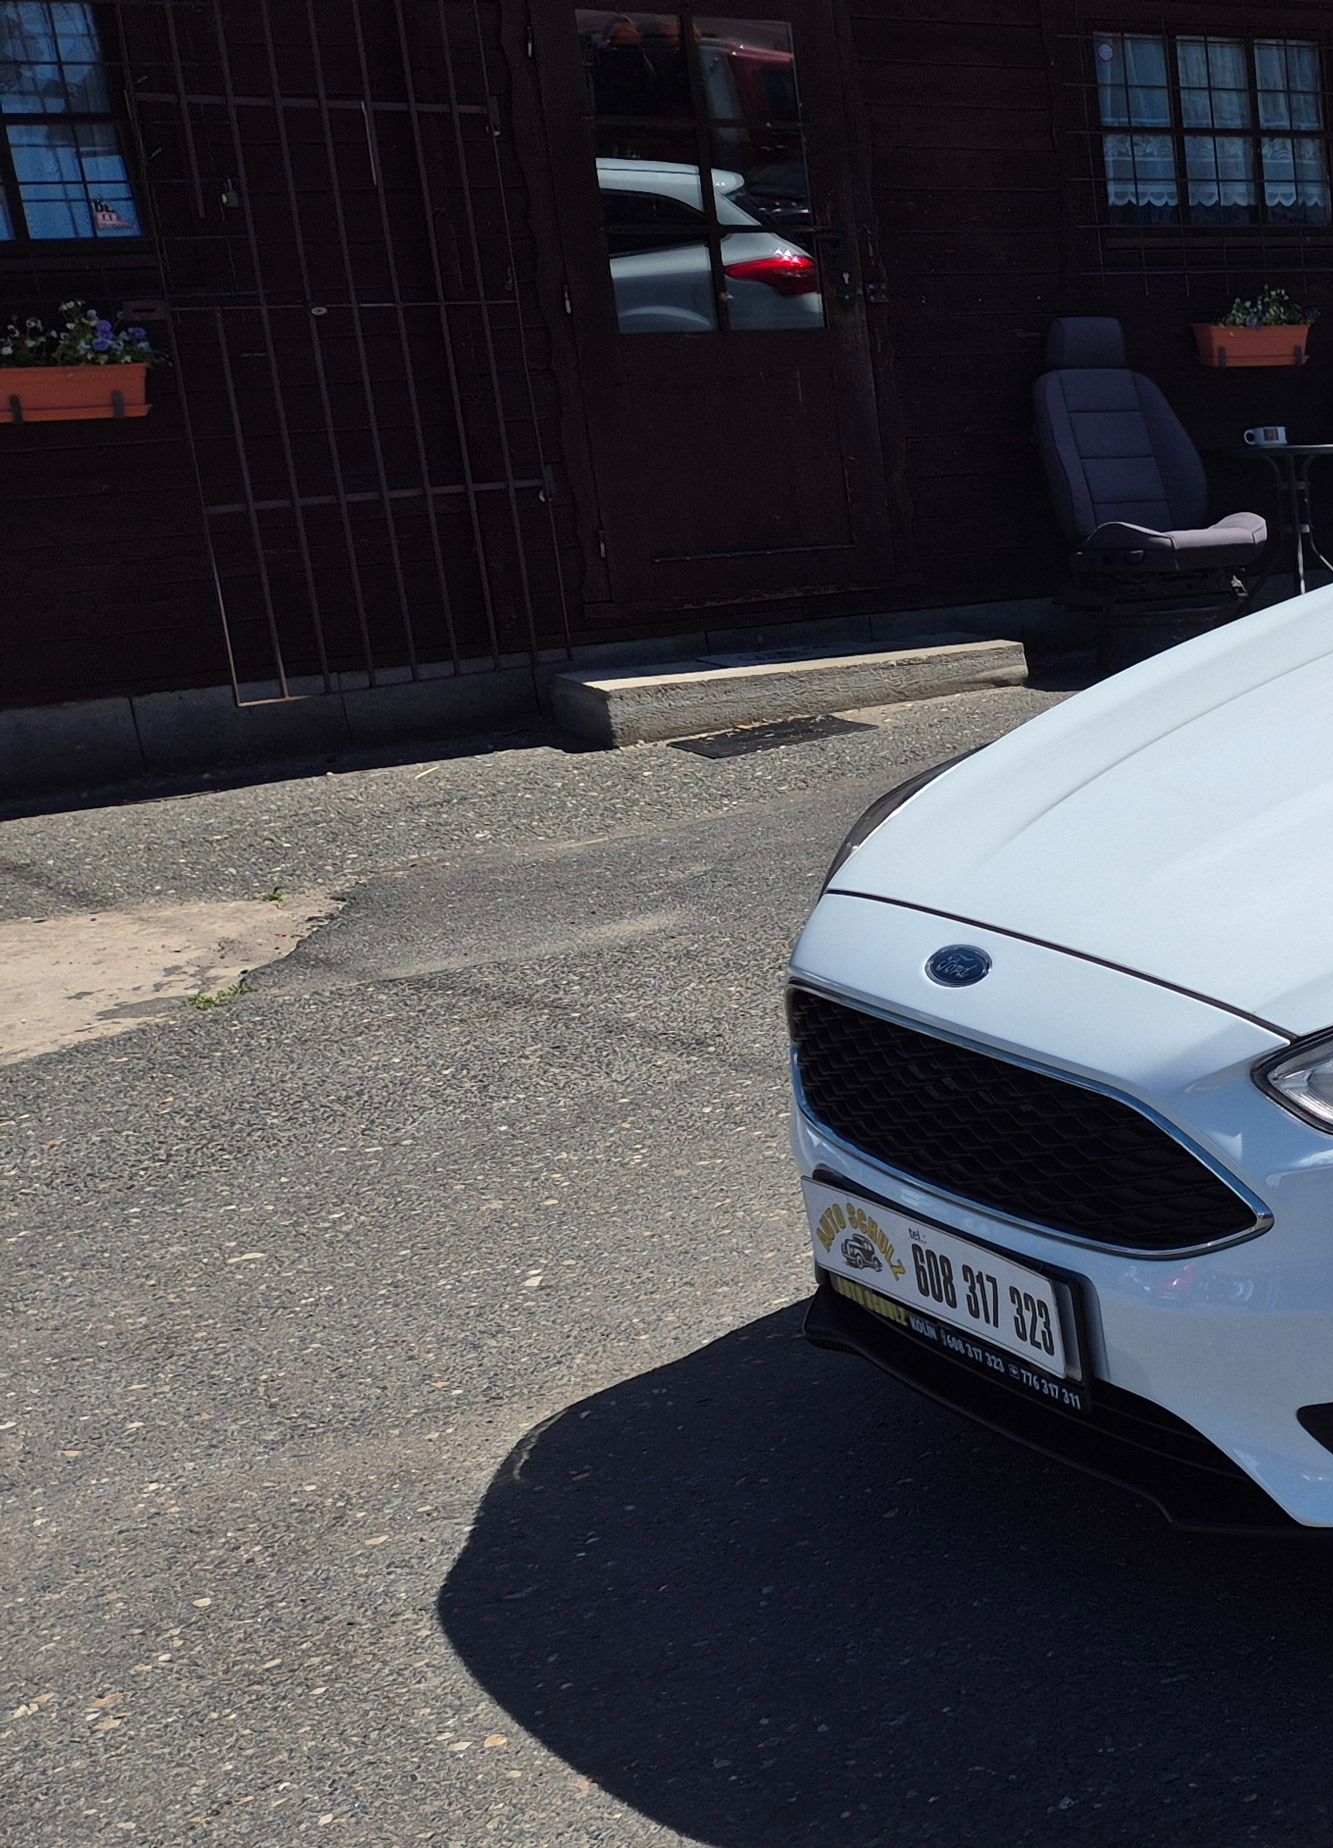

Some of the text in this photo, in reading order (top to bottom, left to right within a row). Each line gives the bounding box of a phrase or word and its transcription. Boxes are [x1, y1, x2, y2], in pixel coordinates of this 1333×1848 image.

[816, 1203, 847, 1254] AUTO
[911, 1243, 1056, 1356] 608 317 323
[1020, 1369, 1040, 1391] 776
[1041, 1379, 1060, 1400] 317
[1061, 1387, 1081, 1410] 311
